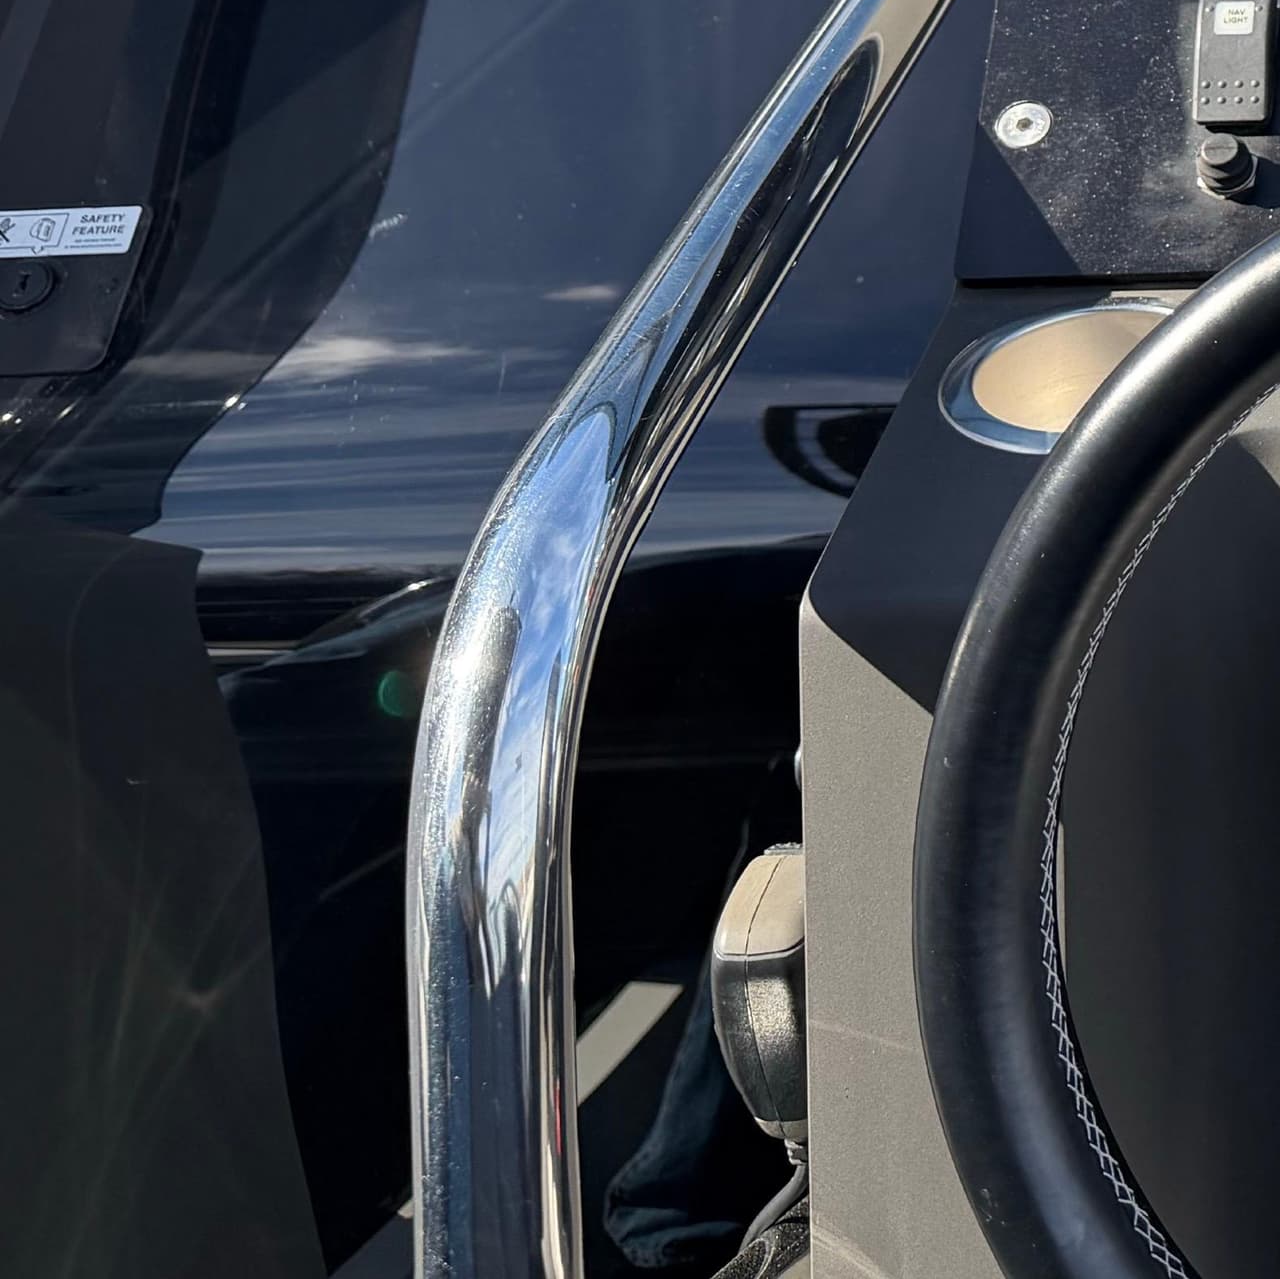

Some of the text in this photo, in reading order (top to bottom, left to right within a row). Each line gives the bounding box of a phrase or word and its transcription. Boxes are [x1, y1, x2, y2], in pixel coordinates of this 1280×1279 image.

[1223, 16, 1249, 24] LIGHT
[80, 213, 126, 224] SAFETY
[71, 224, 126, 236] FEATURE
